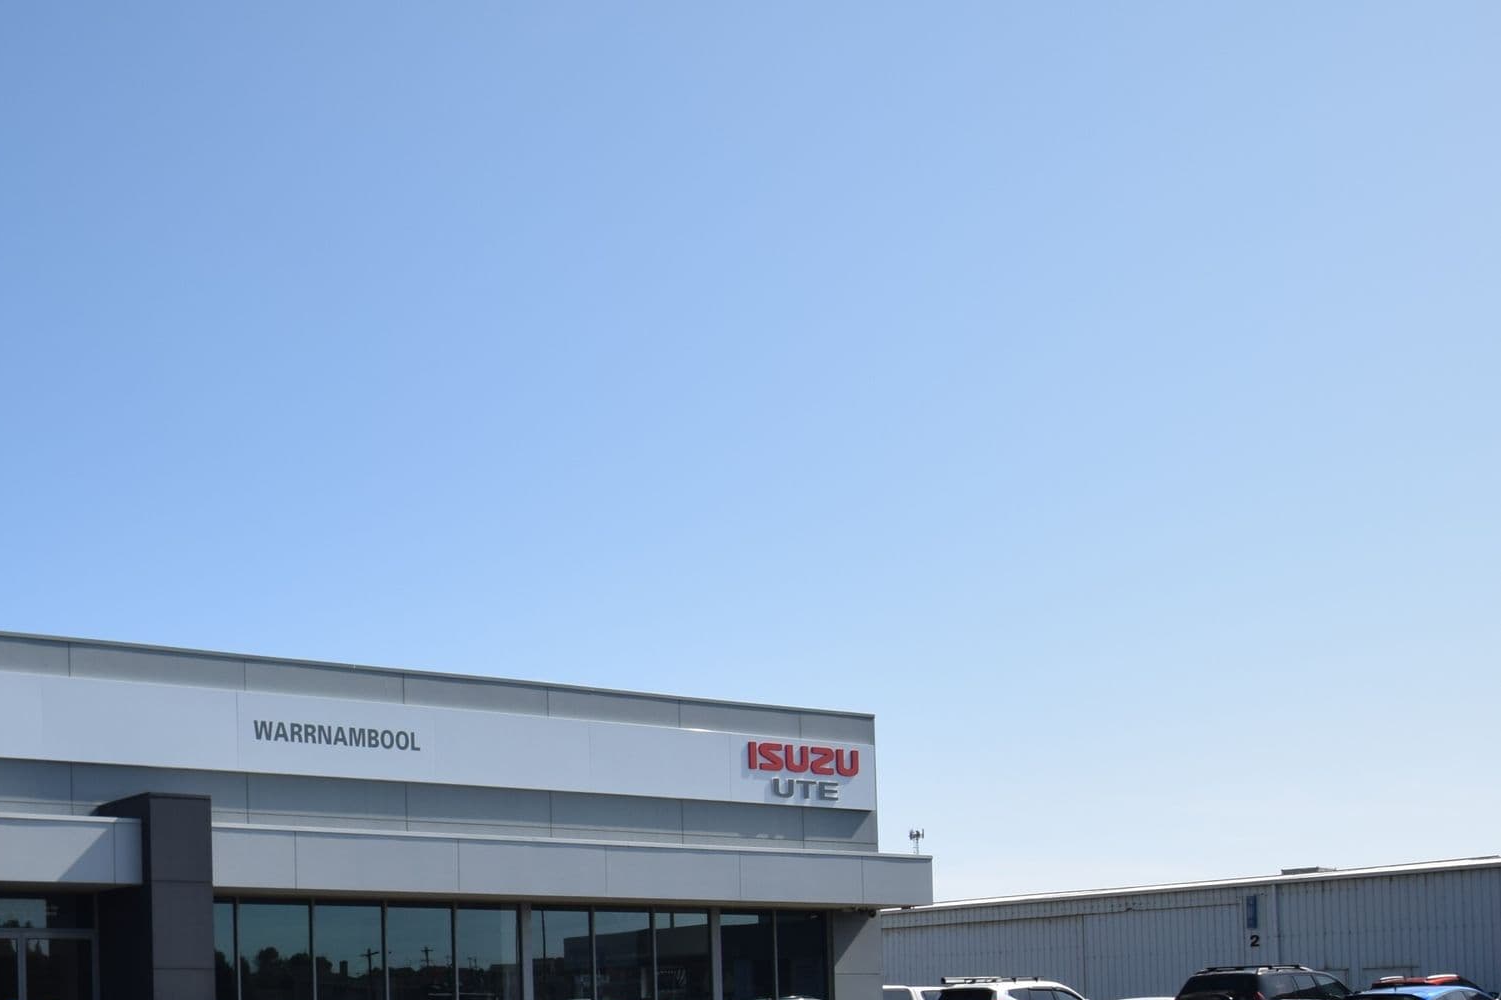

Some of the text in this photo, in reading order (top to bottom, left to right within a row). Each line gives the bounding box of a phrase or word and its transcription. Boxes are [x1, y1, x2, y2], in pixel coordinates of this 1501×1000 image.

[253, 719, 421, 751] WARRNAMBOOL
[747, 741, 860, 777] ISUZU
[771, 778, 839, 801] UTE
[1250, 934, 1260, 948] 2
